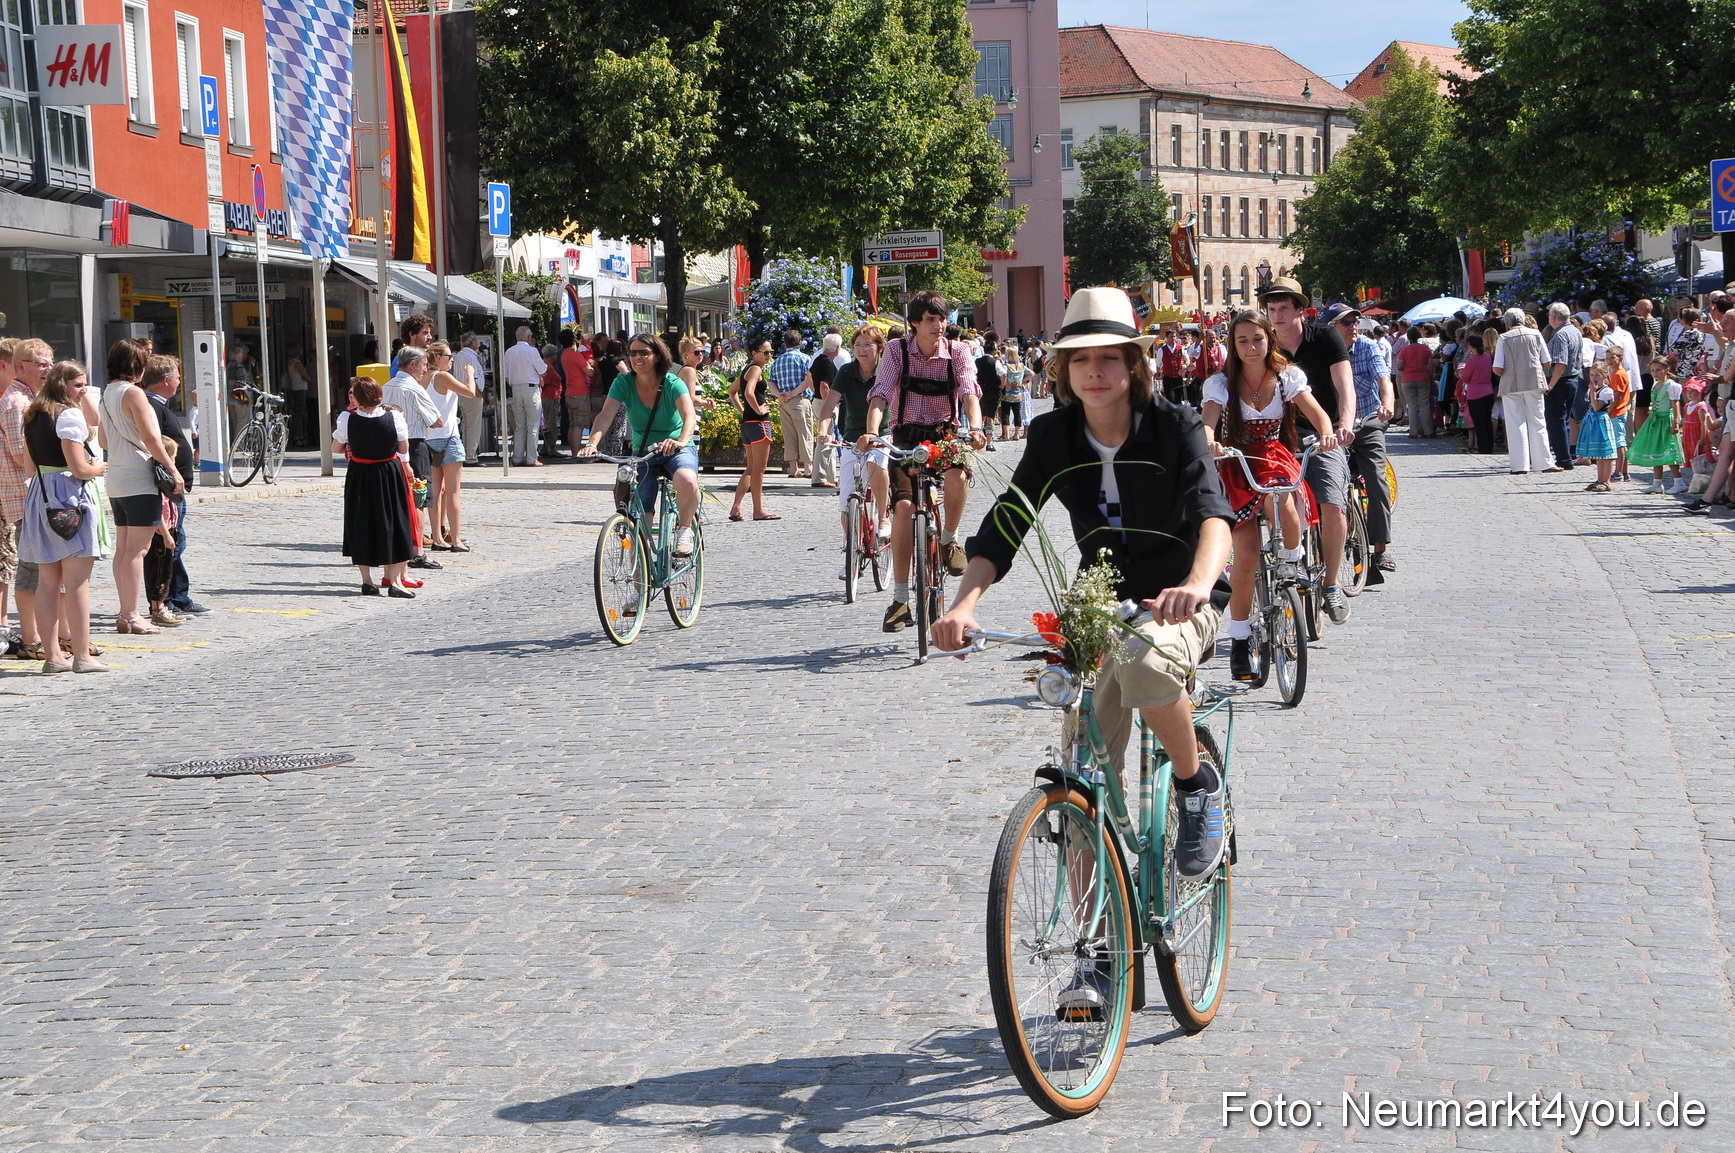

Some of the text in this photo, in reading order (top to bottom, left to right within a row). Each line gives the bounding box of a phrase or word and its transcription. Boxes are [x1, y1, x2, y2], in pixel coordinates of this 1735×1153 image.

[46, 42, 111, 88] H&M
[204, 84, 214, 128] P
[225, 201, 289, 236] TABAKAREN
[493, 190, 505, 228] P
[876, 236, 928, 246] Parkleitsystem
[894, 250, 928, 260] Rosengasse
[168, 282, 190, 293] NZ
